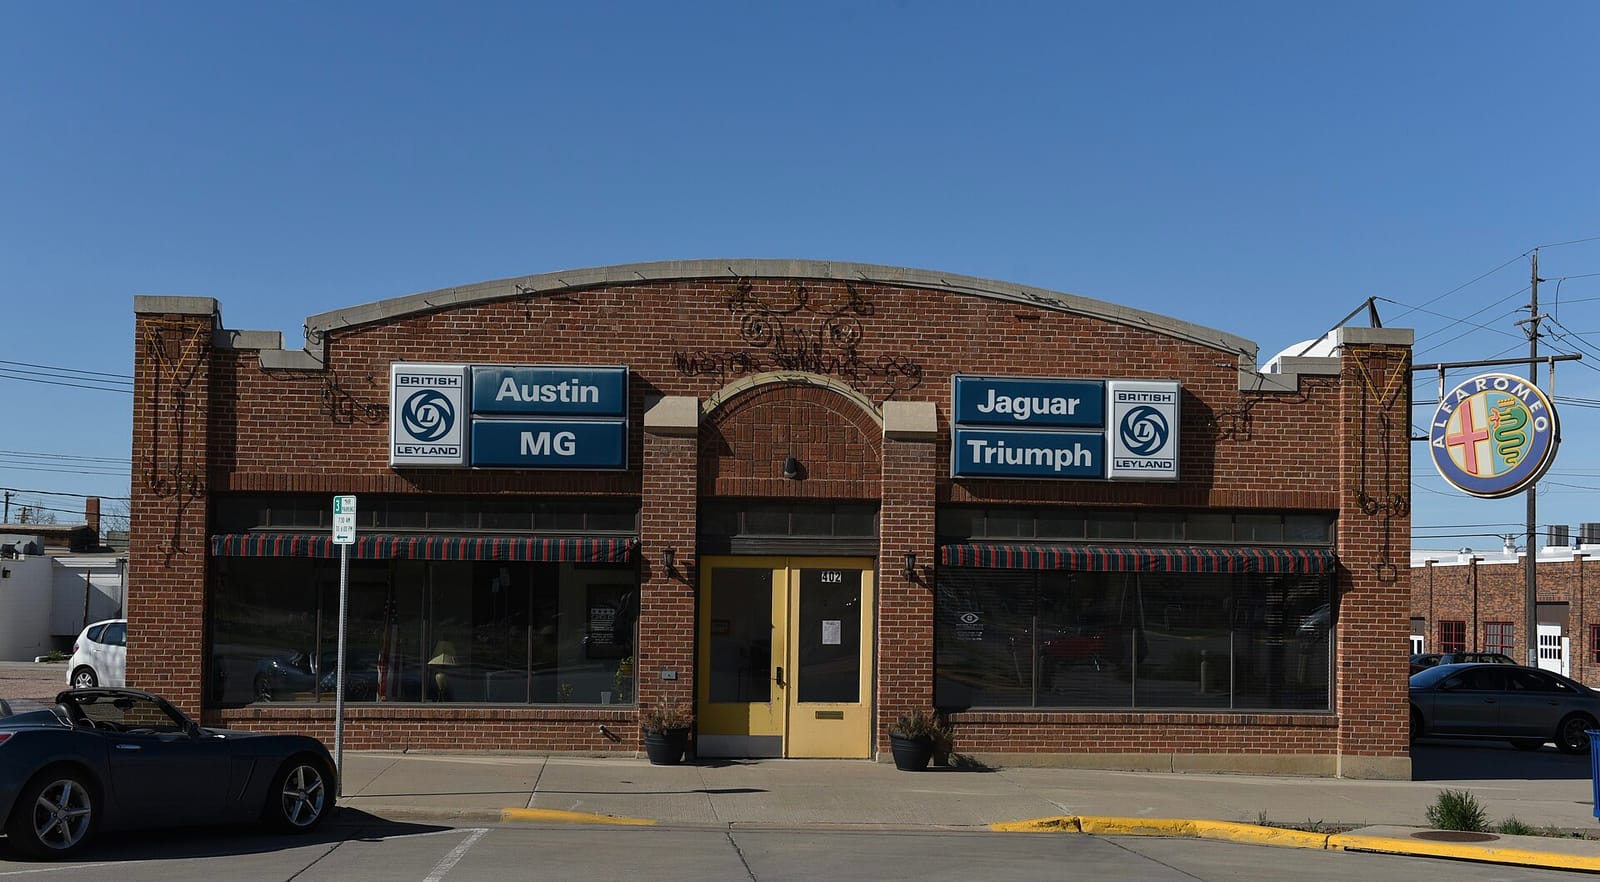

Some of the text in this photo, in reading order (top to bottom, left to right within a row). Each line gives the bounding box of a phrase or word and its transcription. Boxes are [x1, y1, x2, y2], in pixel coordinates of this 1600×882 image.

[400, 376, 458, 386] BRITISH
[495, 377, 599, 403] Austin
[1118, 393, 1172, 402] BRITISH
[976, 389, 1081, 421] Jaguar
[420, 407, 435, 423] L
[1432, 377, 1549, 449] ALFA ROMEO
[1137, 423, 1150, 438] L
[397, 446, 458, 455] LEYLAND
[520, 431, 576, 456] MG
[966, 439, 1092, 472] Triumph
[1116, 460, 1172, 469] LEYLAND
[335, 500, 340, 512] 3
[822, 570, 841, 583] 402
